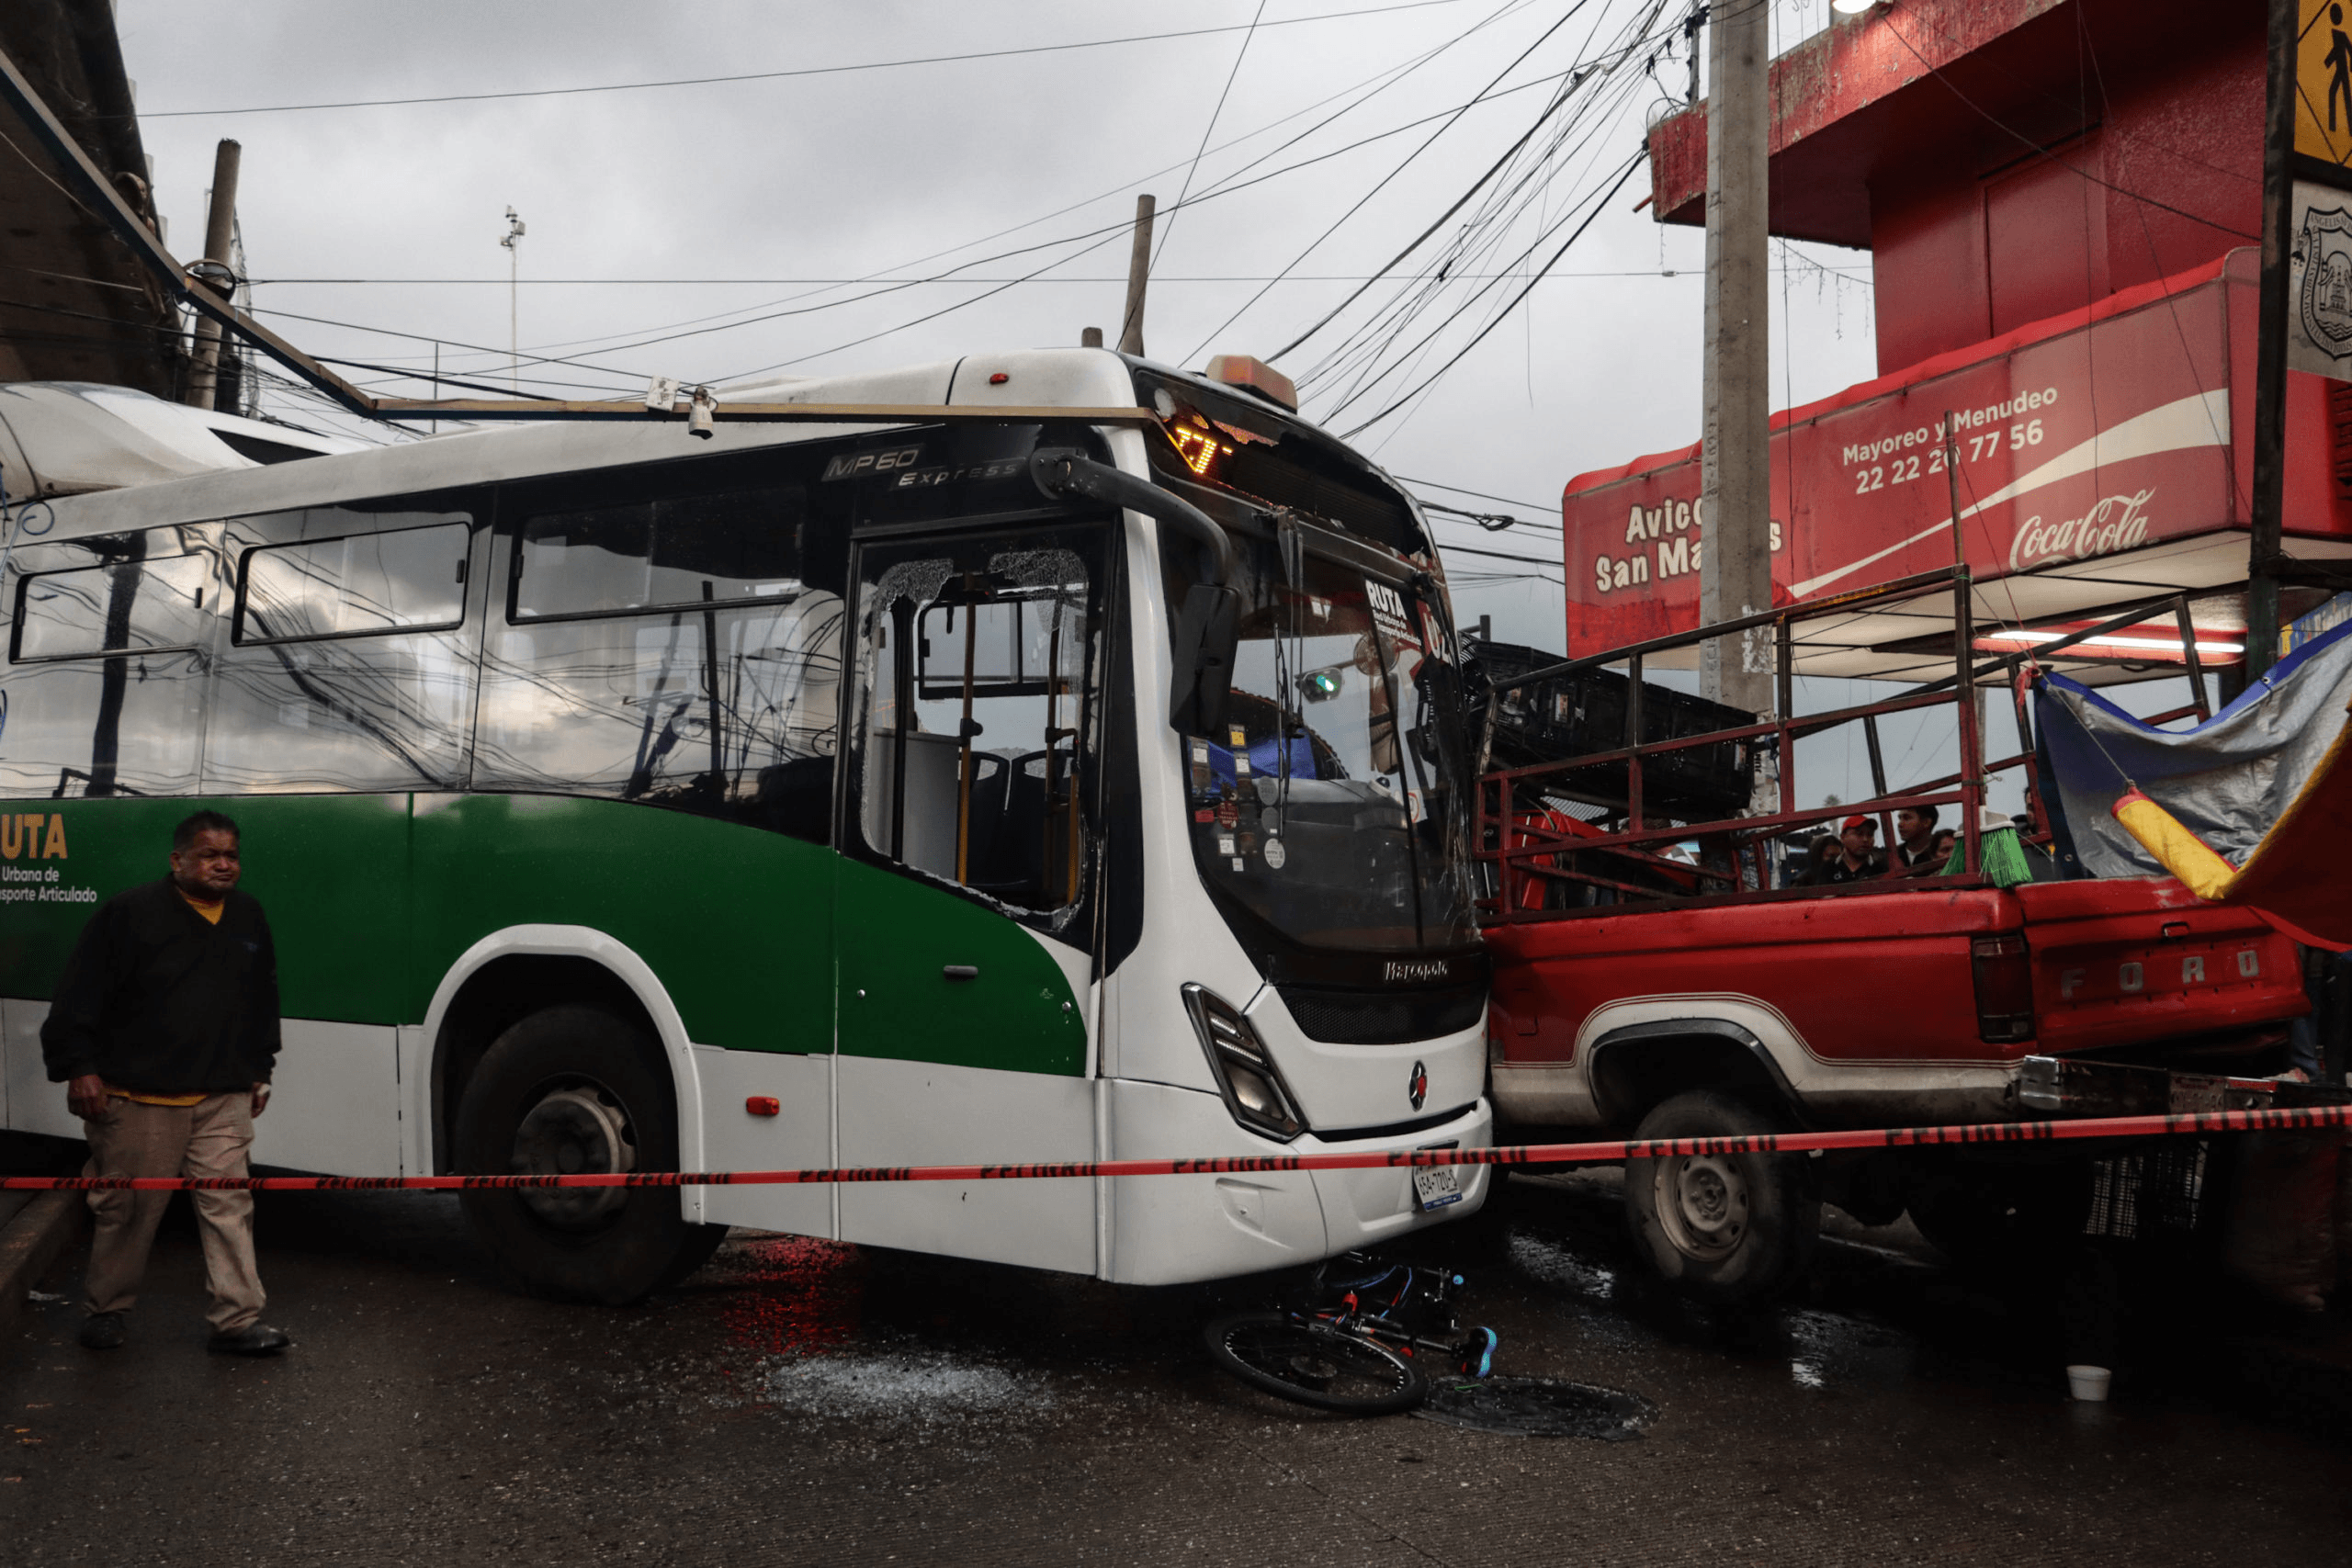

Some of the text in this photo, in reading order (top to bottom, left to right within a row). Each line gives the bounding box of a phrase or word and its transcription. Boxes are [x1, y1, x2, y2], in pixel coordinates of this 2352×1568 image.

[1843, 387, 2059, 467] Mayoreo y Menudeo
[1856, 466, 1884, 494] 22
[1891, 455, 1920, 485] 22
[1969, 431, 2001, 462] 77
[2009, 418, 2044, 450] 56
[2009, 486, 2157, 572] Coca-Cola
[1595, 555, 1649, 592] San
[1365, 579, 1408, 621] RUTA
[2, 865, 60, 882] Urbana de
[38, 886, 97, 903] Articulado
